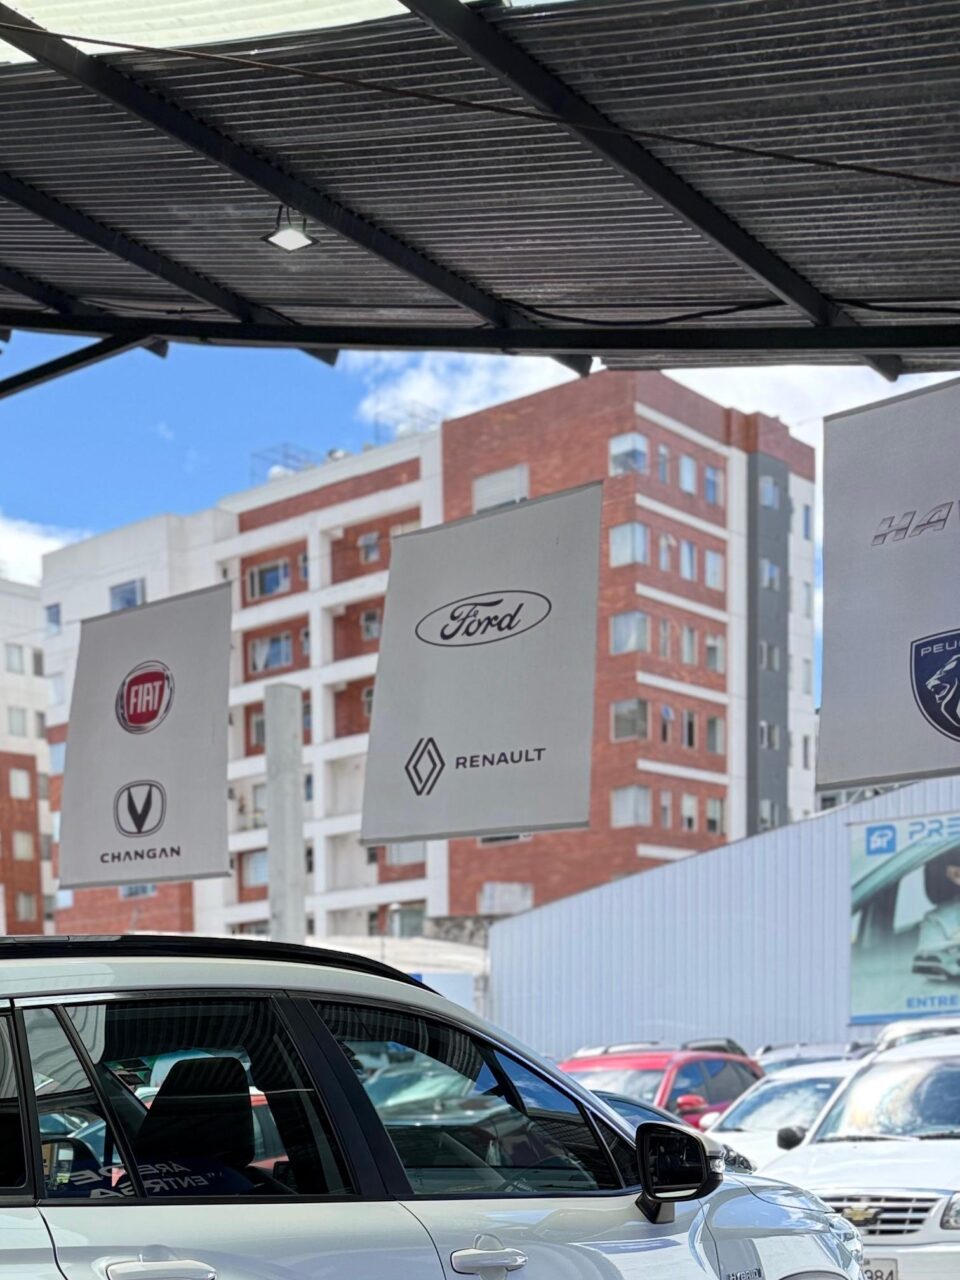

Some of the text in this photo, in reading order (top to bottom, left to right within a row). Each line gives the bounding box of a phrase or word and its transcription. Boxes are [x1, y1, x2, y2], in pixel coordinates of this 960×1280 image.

[871, 501, 960, 546] HA
[440, 599, 524, 640] Ford
[921, 639, 960, 656] PEU
[130, 681, 162, 714] FIAT
[455, 748, 546, 769] RENAULT
[100, 846, 181, 863] CHANGAN
[906, 995, 959, 1009] ENTRE
